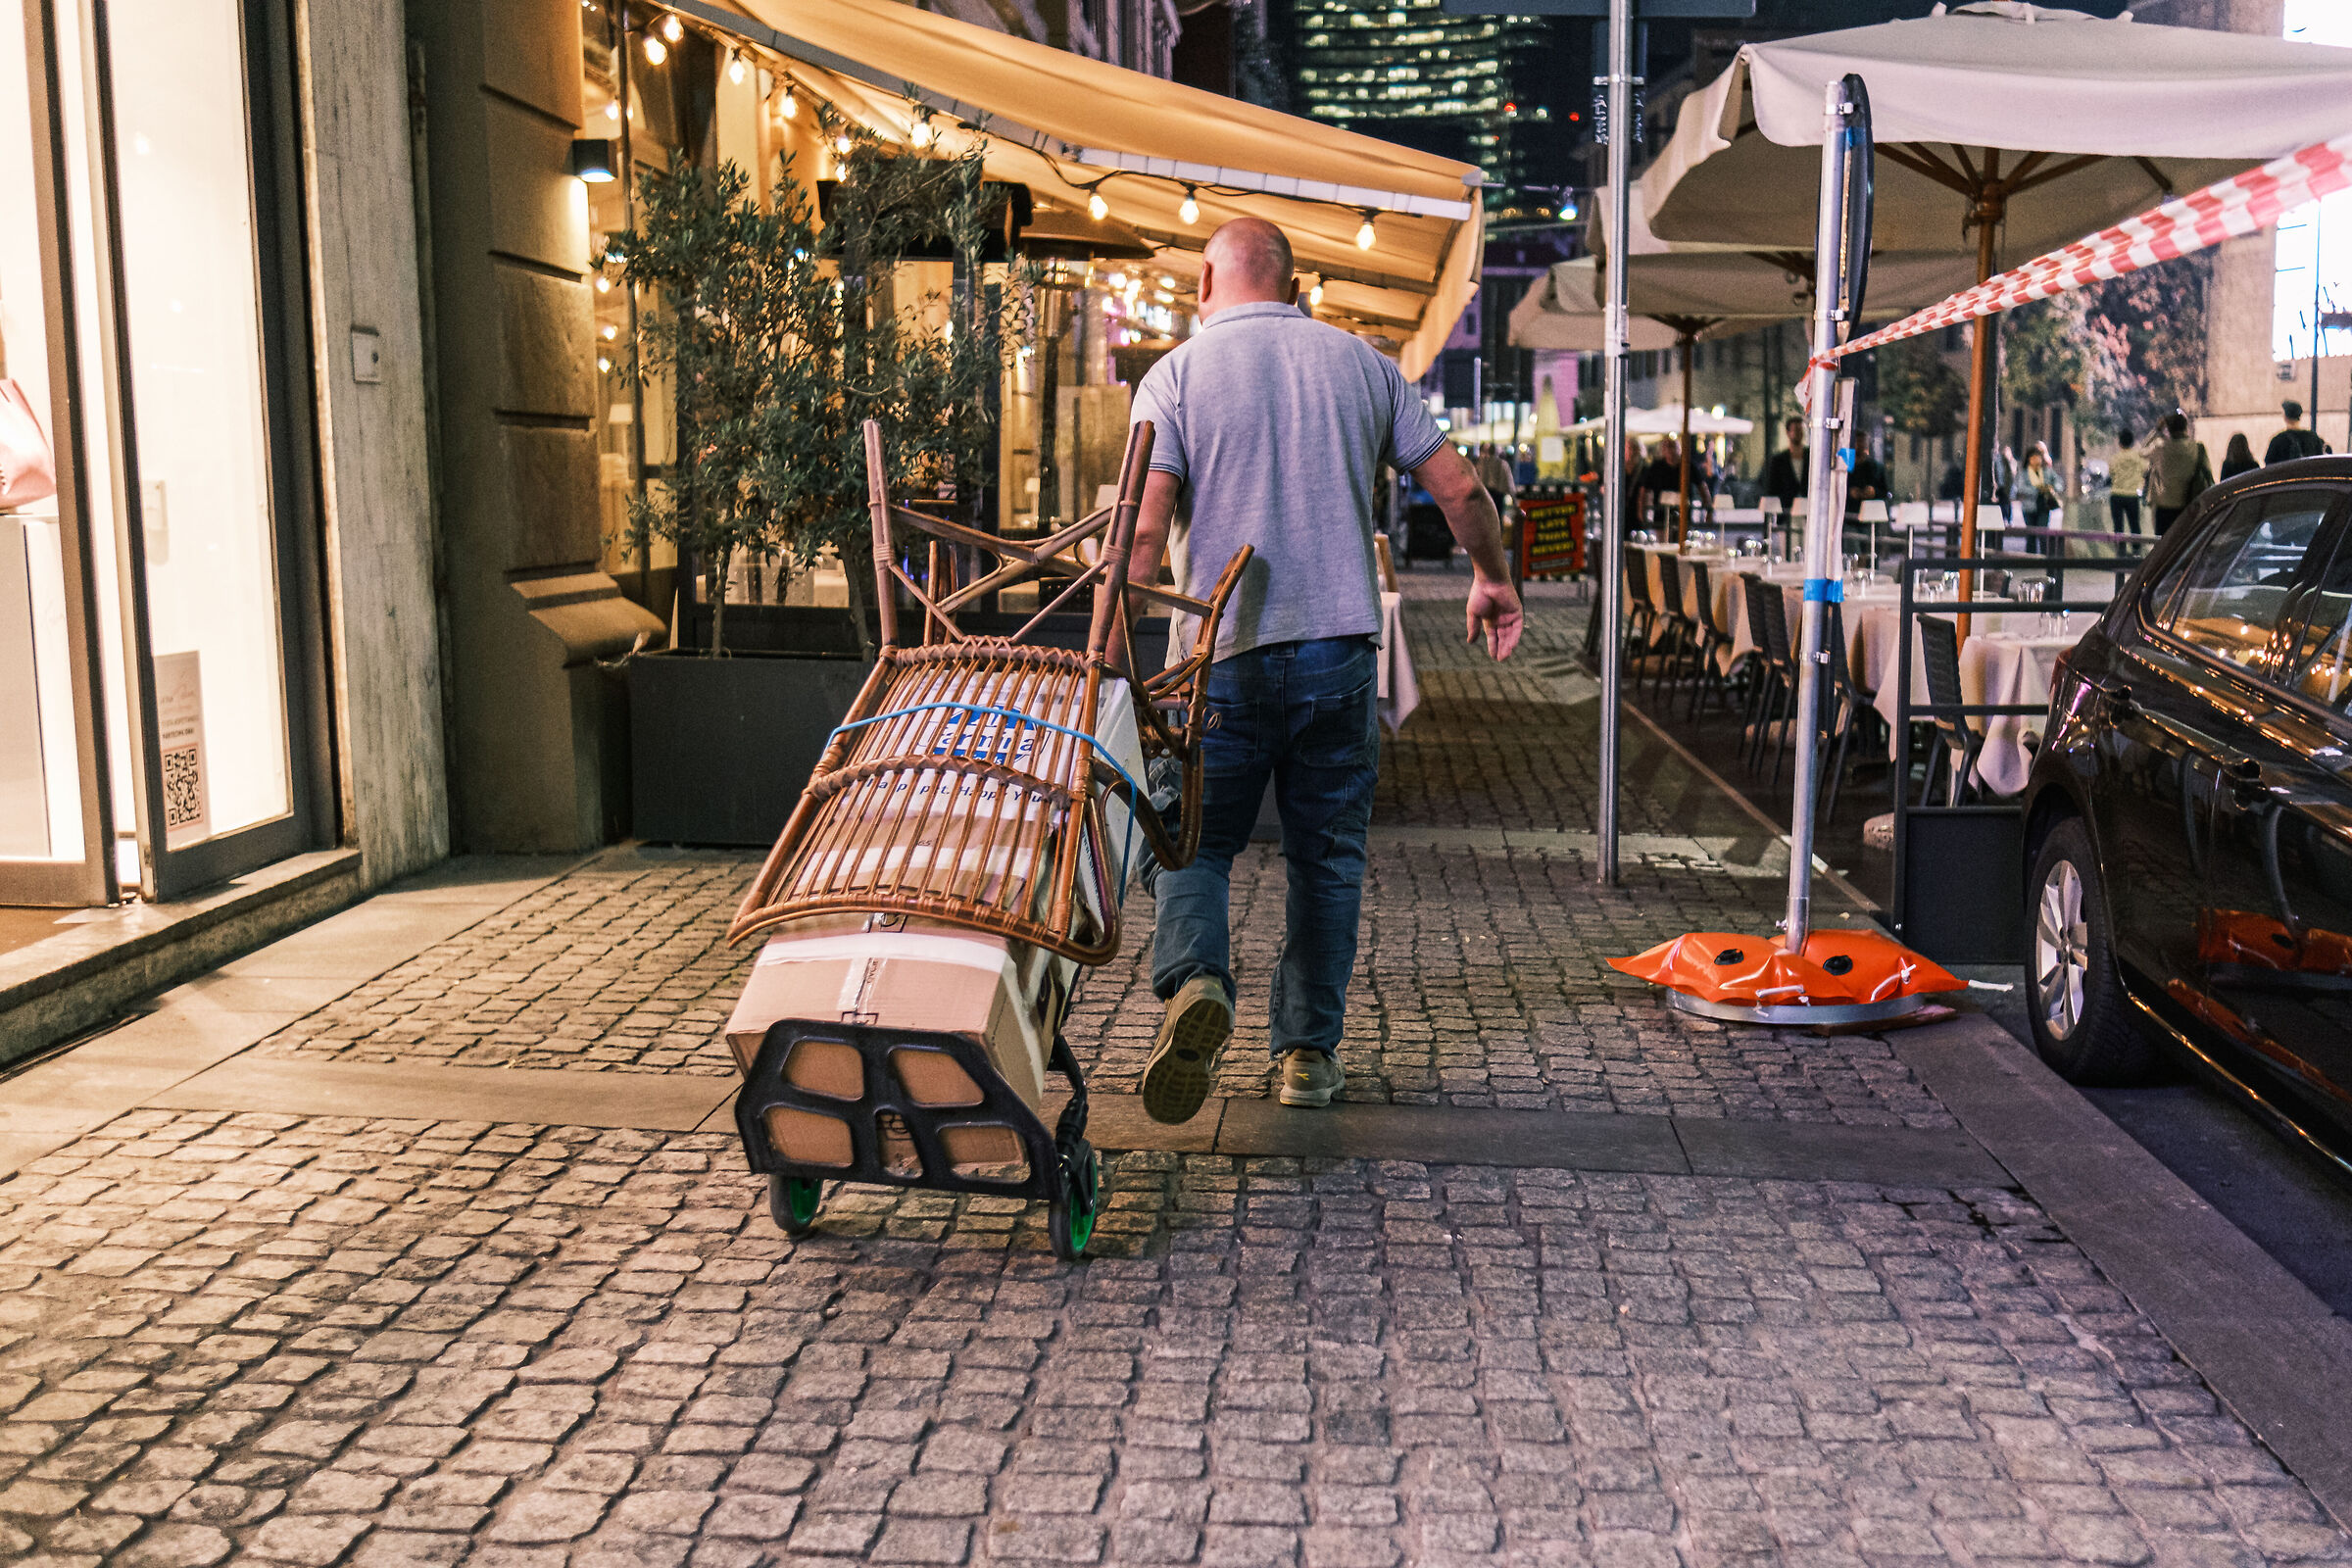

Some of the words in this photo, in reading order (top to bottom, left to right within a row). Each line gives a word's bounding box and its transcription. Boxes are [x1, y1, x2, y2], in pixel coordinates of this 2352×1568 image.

[1532, 504, 1576, 518] BETTER
[1540, 518, 1567, 530] LATE
[1538, 530, 1569, 542] THAN
